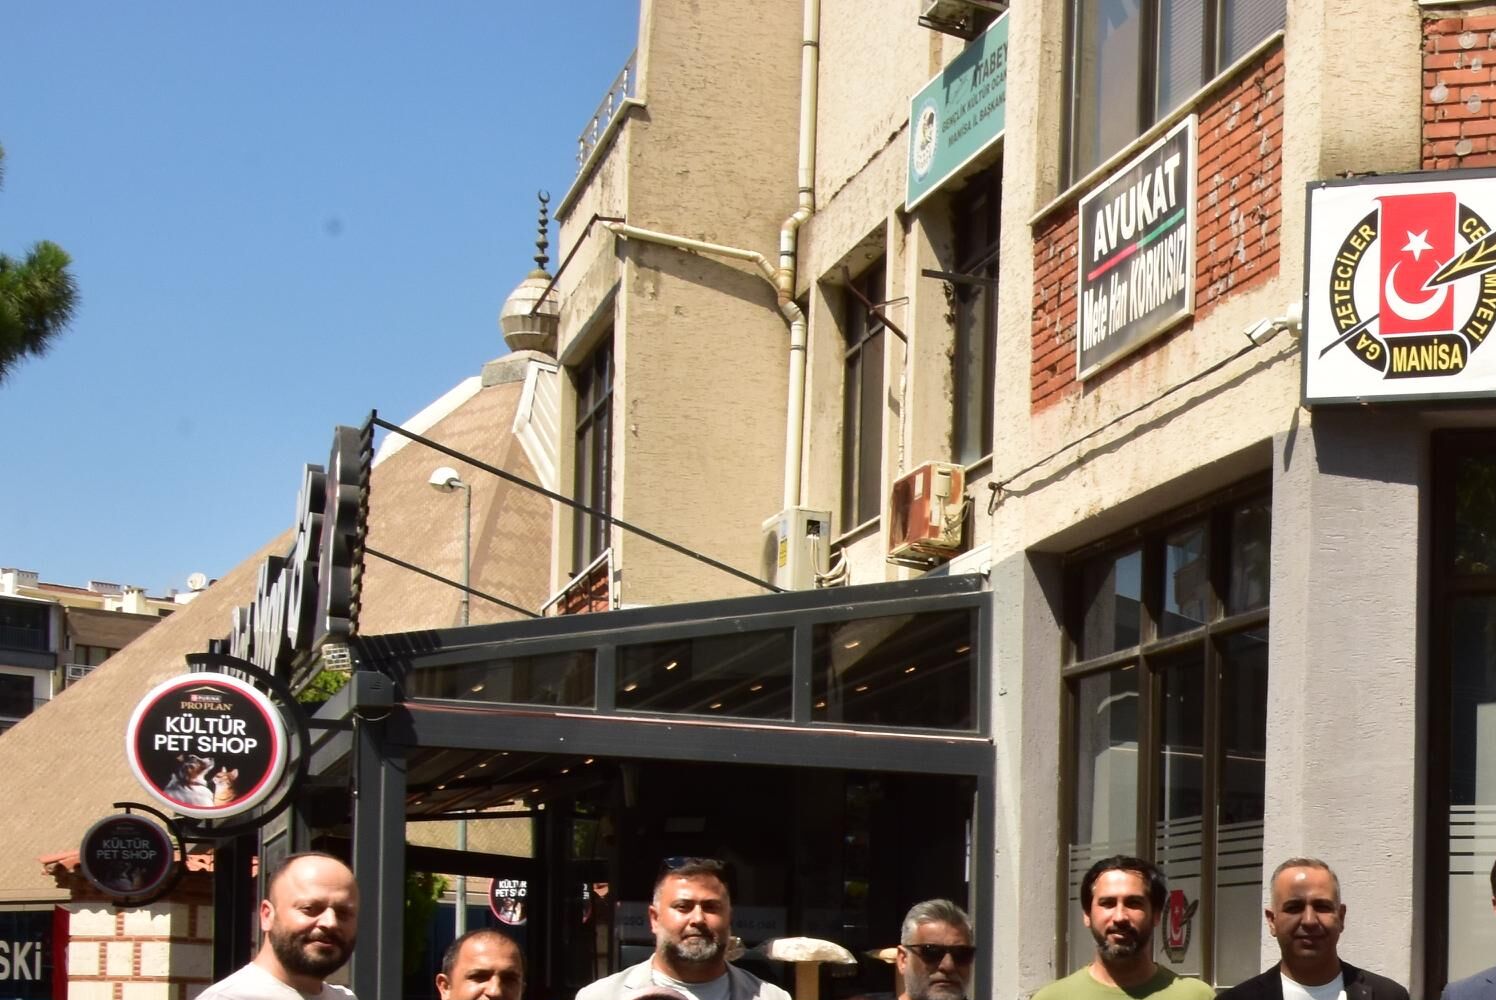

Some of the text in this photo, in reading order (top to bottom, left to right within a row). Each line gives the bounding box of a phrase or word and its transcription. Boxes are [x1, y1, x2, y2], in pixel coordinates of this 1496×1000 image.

[1093, 152, 1181, 262] AVUKAT
[1083, 223, 1186, 351] Mete Han KORKUSUZ
[1392, 338, 1463, 373] MANİSA
[181, 701, 203, 710] PRO
[166, 713, 246, 736] KÜLTÜR
[154, 734, 258, 754] PET SHOP
[103, 837, 150, 849] KÜLTÜR
[96, 849, 157, 860] PET SHOP
